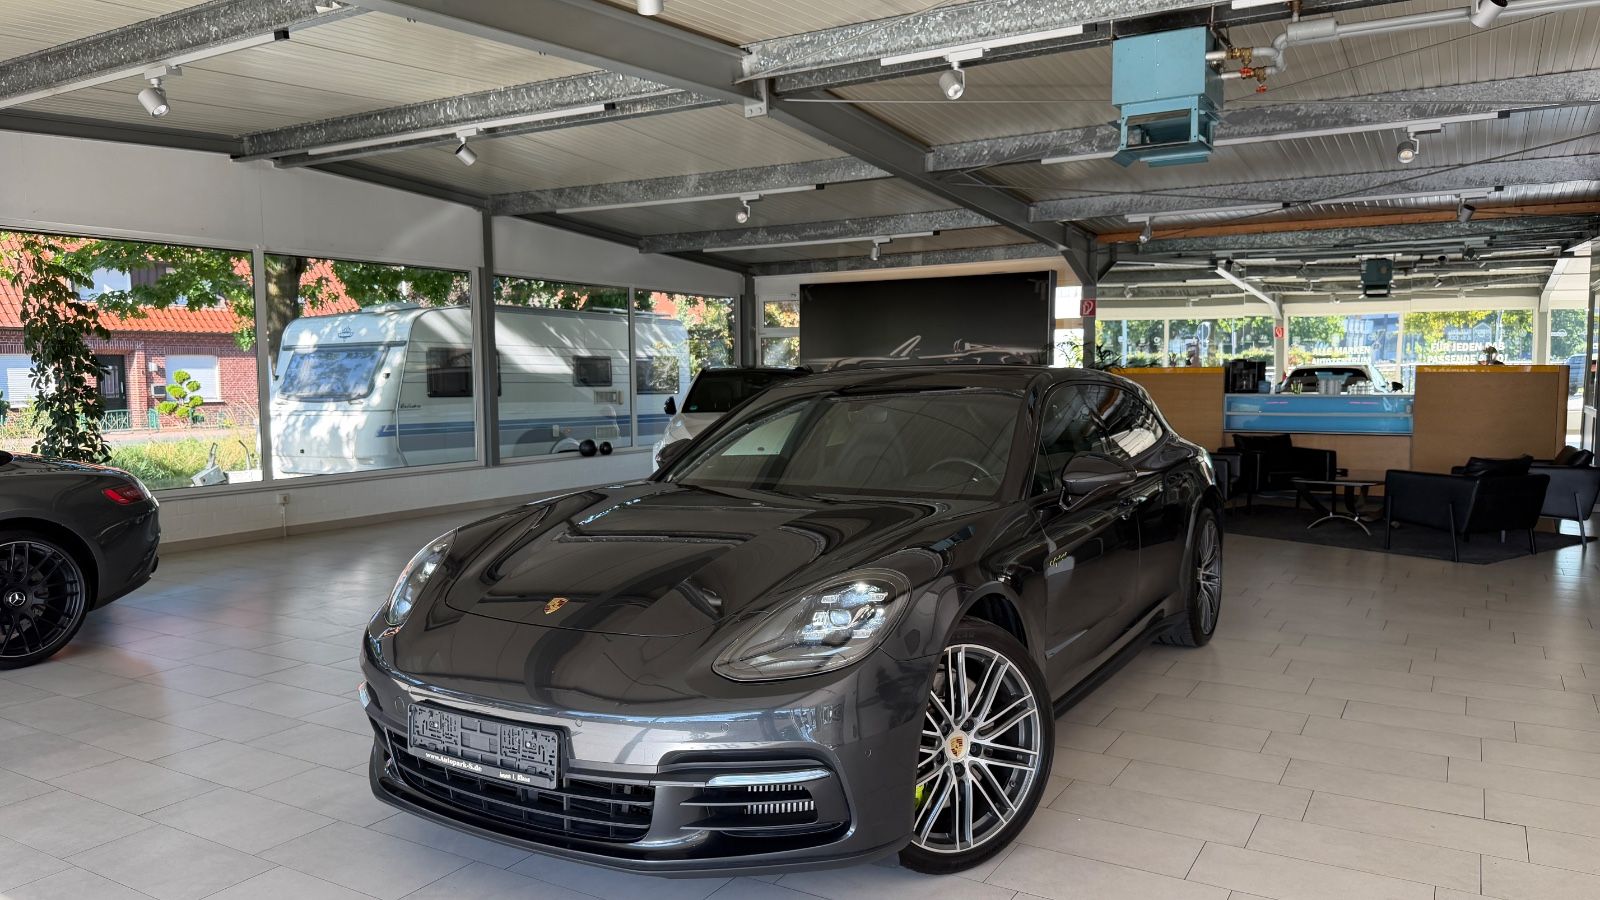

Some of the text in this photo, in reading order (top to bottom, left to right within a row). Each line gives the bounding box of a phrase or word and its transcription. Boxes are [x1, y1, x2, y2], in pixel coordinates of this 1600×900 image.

[1312, 346, 1371, 356] ALLE MARKEN
[1452, 342, 1483, 351] JEDEN
[1427, 353, 1476, 363] PASSENDE
